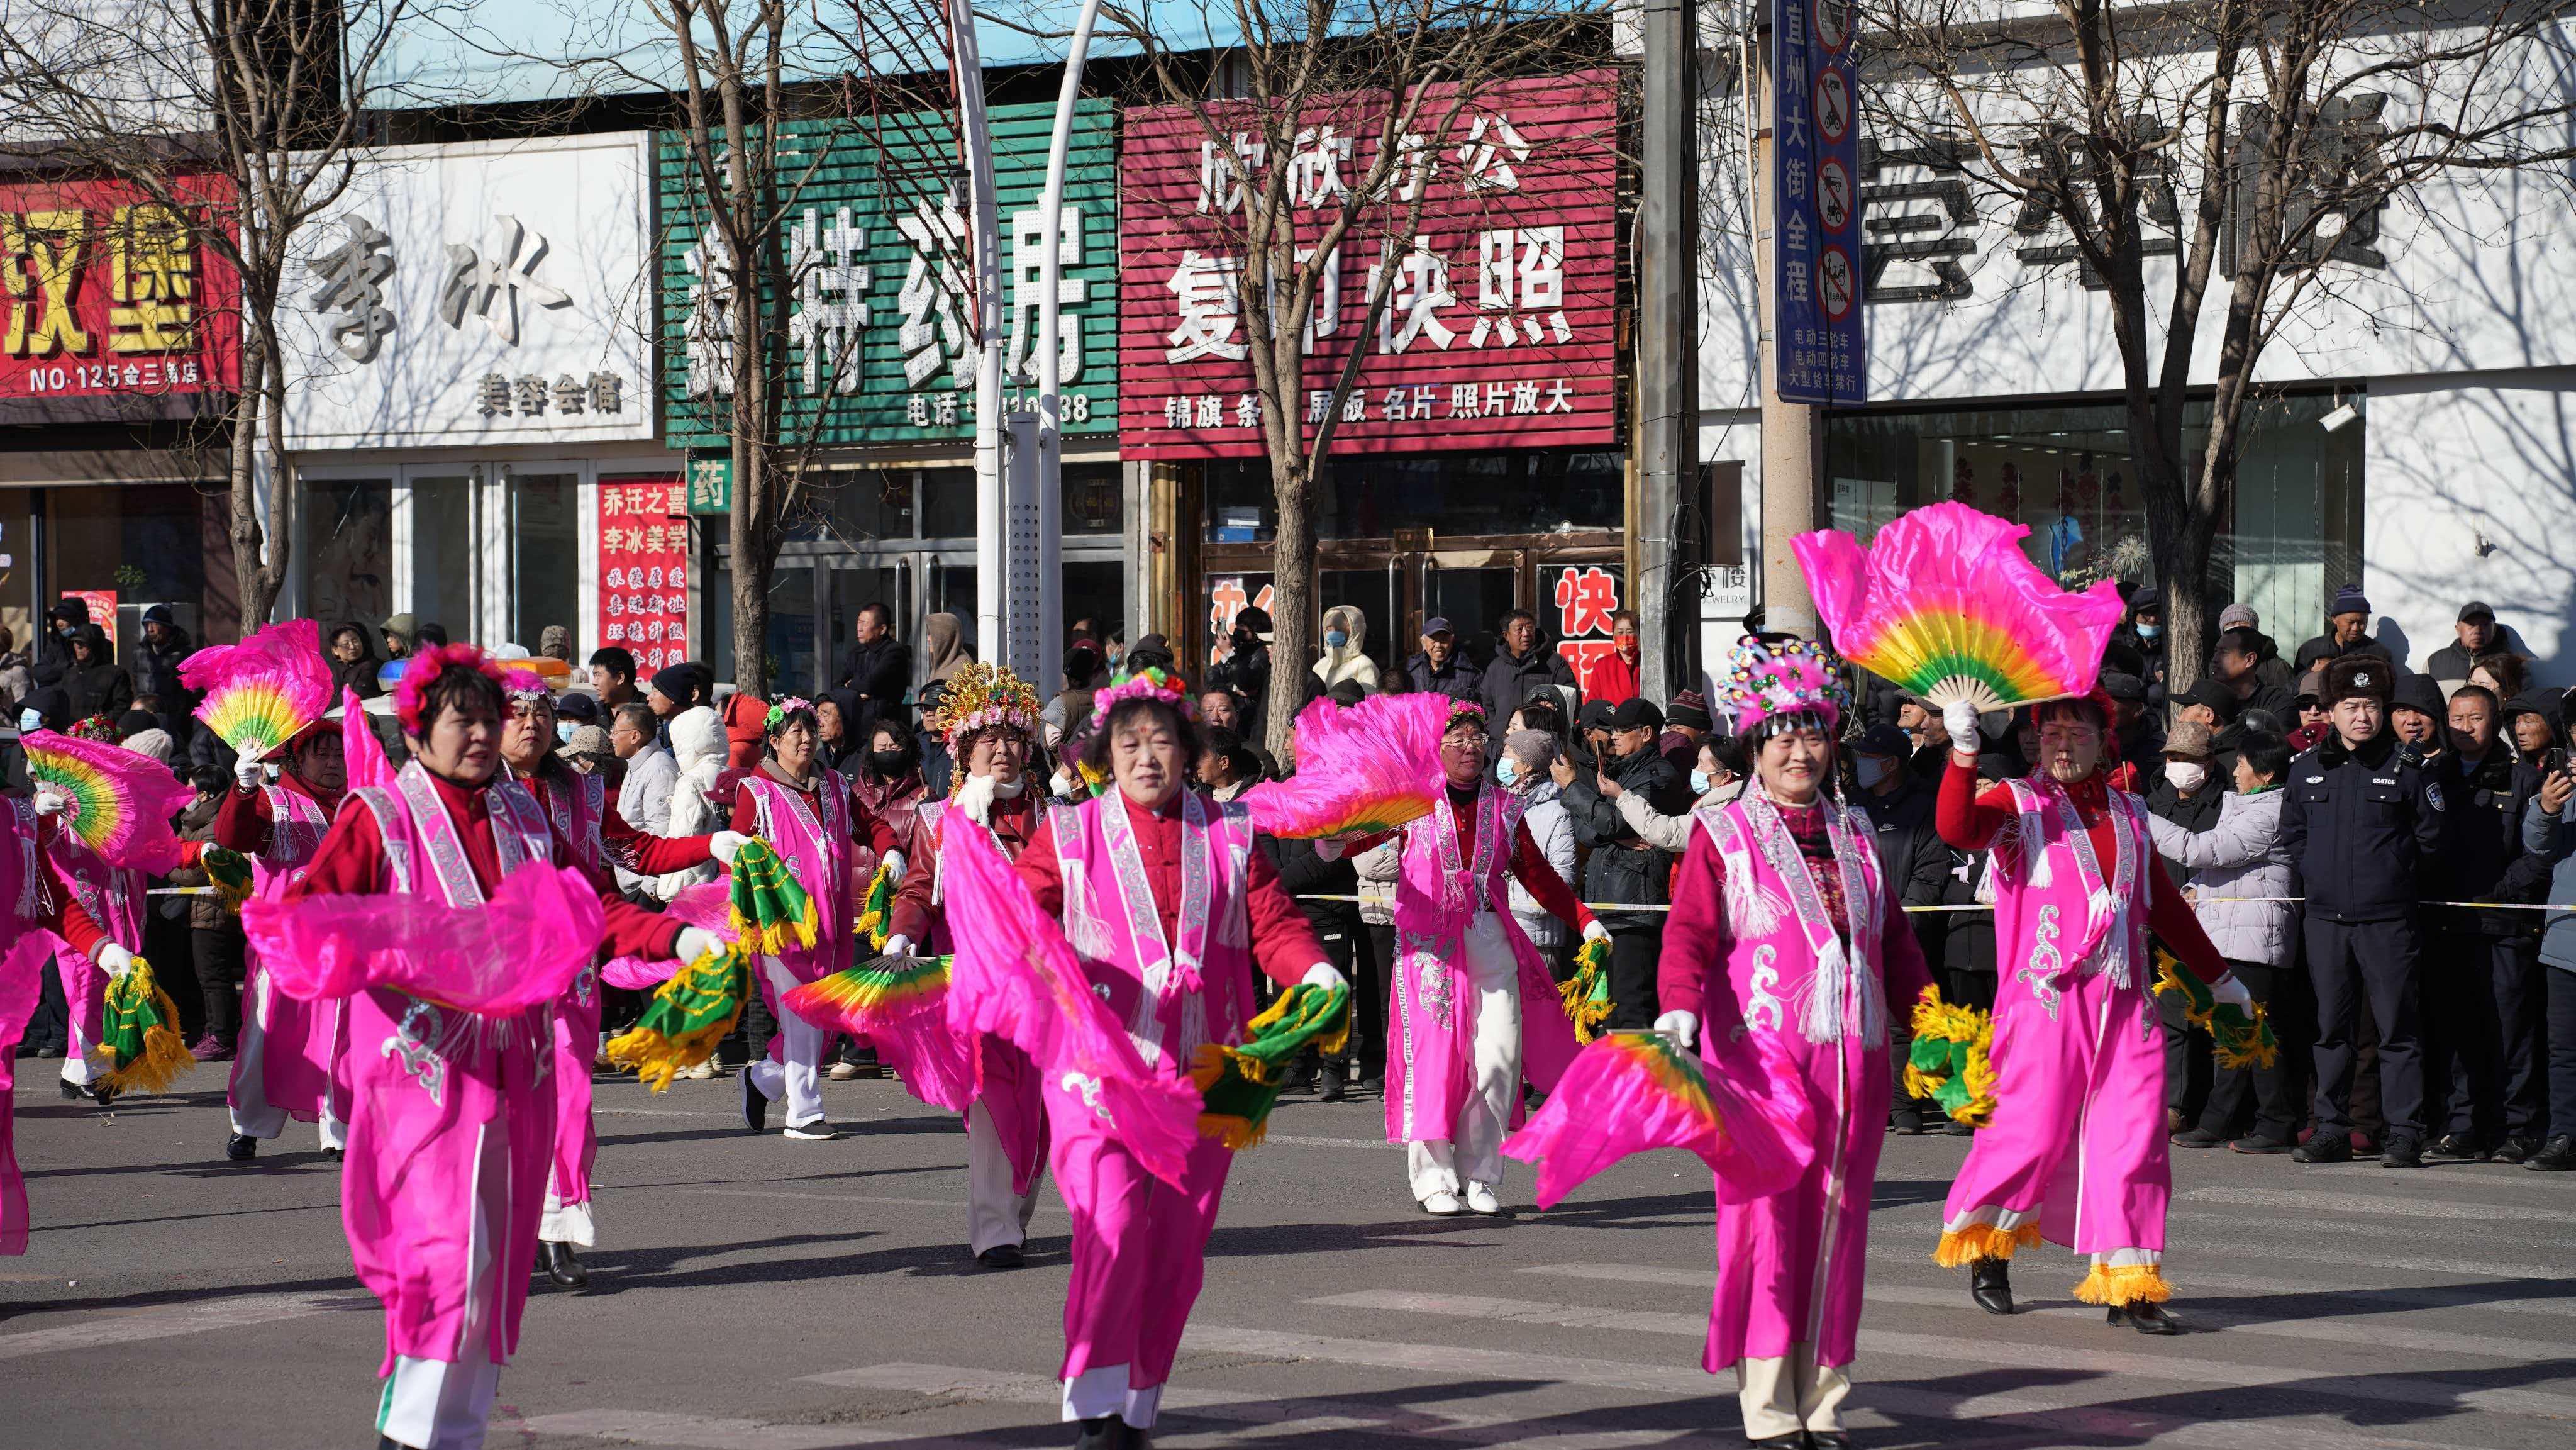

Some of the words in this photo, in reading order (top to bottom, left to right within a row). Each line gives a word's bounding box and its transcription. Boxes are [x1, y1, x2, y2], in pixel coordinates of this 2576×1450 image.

[1785, 1, 1808, 303] 宜州大街全程
[2, 205, 192, 355] 汉堡
[306, 213, 570, 363] 李冰
[1794, 327, 1849, 350] 电动三轮车
[1794, 348, 1850, 371] 电动四轮车
[476, 370, 623, 416] 美容会馆
[1789, 369, 1857, 393] 大型货车禁行
[1164, 394, 1224, 428] 锦旗
[1382, 385, 1437, 420] 名片
[1448, 379, 1574, 420] 照片放大
[692, 460, 725, 507] 药
[604, 486, 686, 516] 乔迁之喜
[604, 525, 686, 554] 李冰美学
[607, 566, 684, 589] 承蒙厚爱
[607, 594, 686, 616] 喜迁新址
[607, 620, 686, 643] 环境升级
